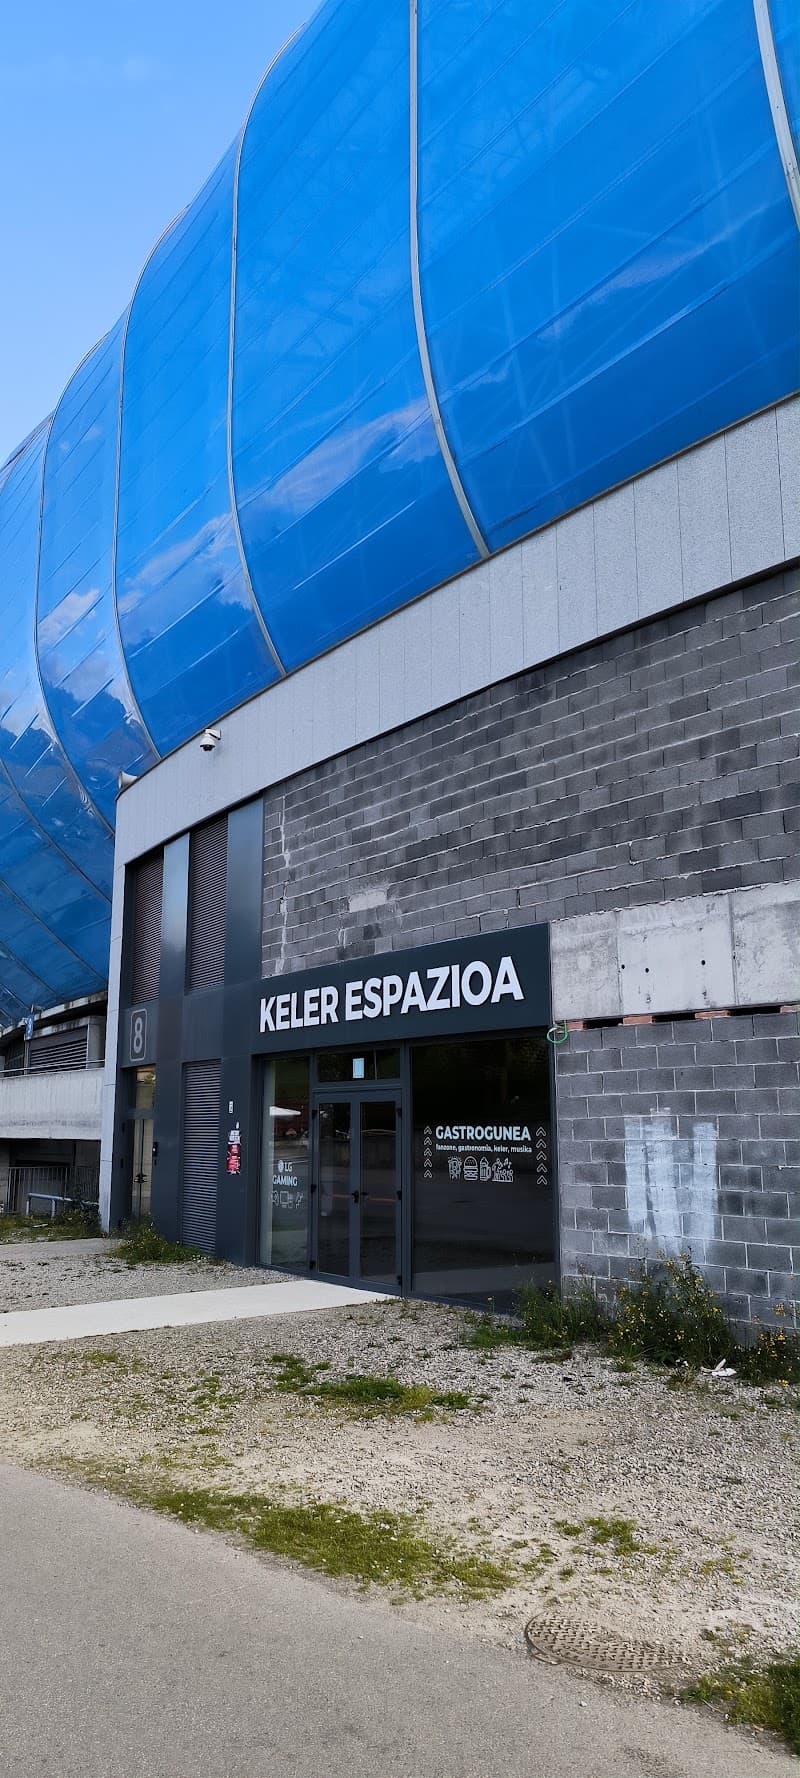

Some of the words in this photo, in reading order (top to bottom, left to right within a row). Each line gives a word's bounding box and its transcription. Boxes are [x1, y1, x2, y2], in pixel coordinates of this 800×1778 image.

[260, 986, 338, 1033] KELER
[345, 956, 524, 1021] ESPAZIOA
[133, 1017, 142, 1054] 8
[435, 1126, 531, 1141] GASTROGUNEA
[493, 1145, 510, 1154] keler,
[511, 1145, 532, 1153] musika
[284, 1162, 293, 1172] LG
[272, 1175, 298, 1187] GAMING
